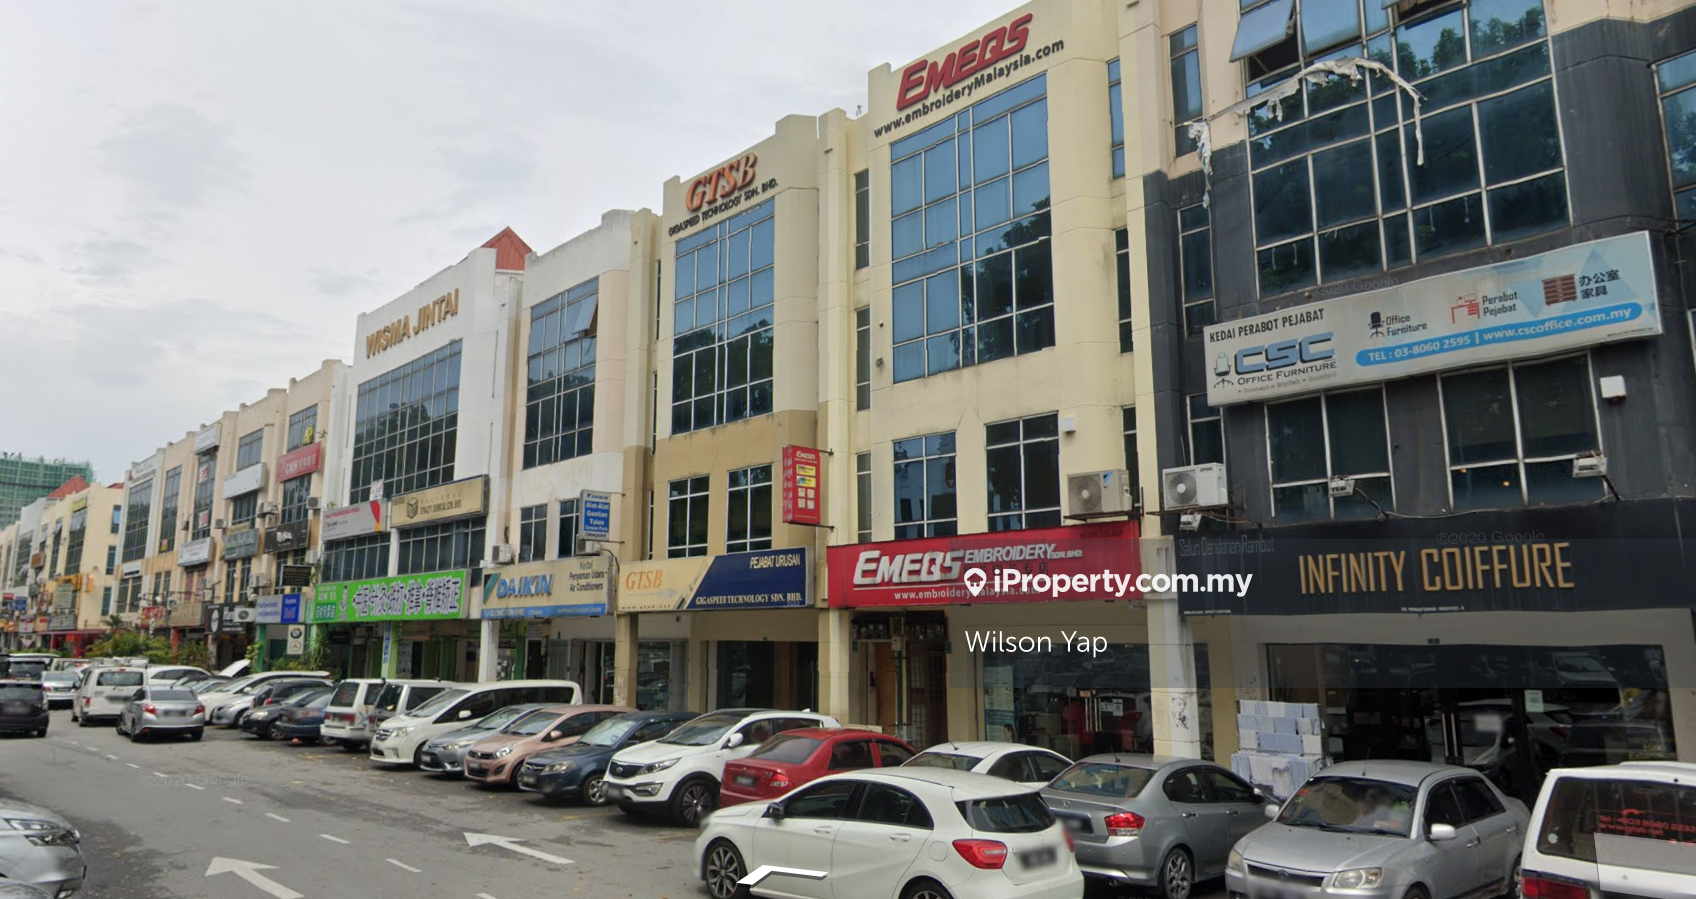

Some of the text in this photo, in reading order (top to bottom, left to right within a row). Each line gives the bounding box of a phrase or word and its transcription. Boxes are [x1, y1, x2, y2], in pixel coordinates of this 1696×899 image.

[896, 13, 1033, 111] EMEQS
[874, 40, 1064, 138] www.embroideryMalaysia.com
[685, 153, 757, 213] GTSB
[701, 194, 742, 221] TECHNOLOGY
[1580, 270, 1620, 287] 办公室
[1482, 291, 1518, 305] Perabot
[1582, 286, 1607, 300] 家具
[1385, 314, 1411, 327] Office
[1484, 303, 1517, 318] Pejabat
[366, 288, 460, 359] WISMA JINTAI
[1210, 309, 1324, 343] KEDAI PERABOT PEJABAT
[1369, 351, 1387, 361] TEL
[1394, 342, 1440, 359] 03-8060
[1443, 334, 1472, 350] 2595
[1483, 307, 1632, 341] www.cscoffice.com.my
[1386, 322, 1428, 337] Furniture
[1234, 331, 1336, 375] CSC
[1237, 362, 1337, 386] OFFICE FURNITURE
[586, 502, 609, 510] Alat-Alat
[586, 510, 607, 518] Gantian
[589, 518, 605, 526] Tulen
[1241, 533, 1275, 554] Rambut
[750, 554, 801, 569] PEJABAT URUSAN
[853, 548, 965, 585] EMEQS
[965, 543, 1056, 564] EMBROIDERY
[1298, 543, 1574, 595] INFINITY COIFFURE
[497, 574, 553, 599] DAIKIN
[577, 582, 604, 592] Conditioners
[625, 570, 663, 591] GTSB
[727, 594, 769, 604] TECHNOLOGY
[771, 592, 785, 602] SDN.
[786, 592, 803, 602] BHD.
